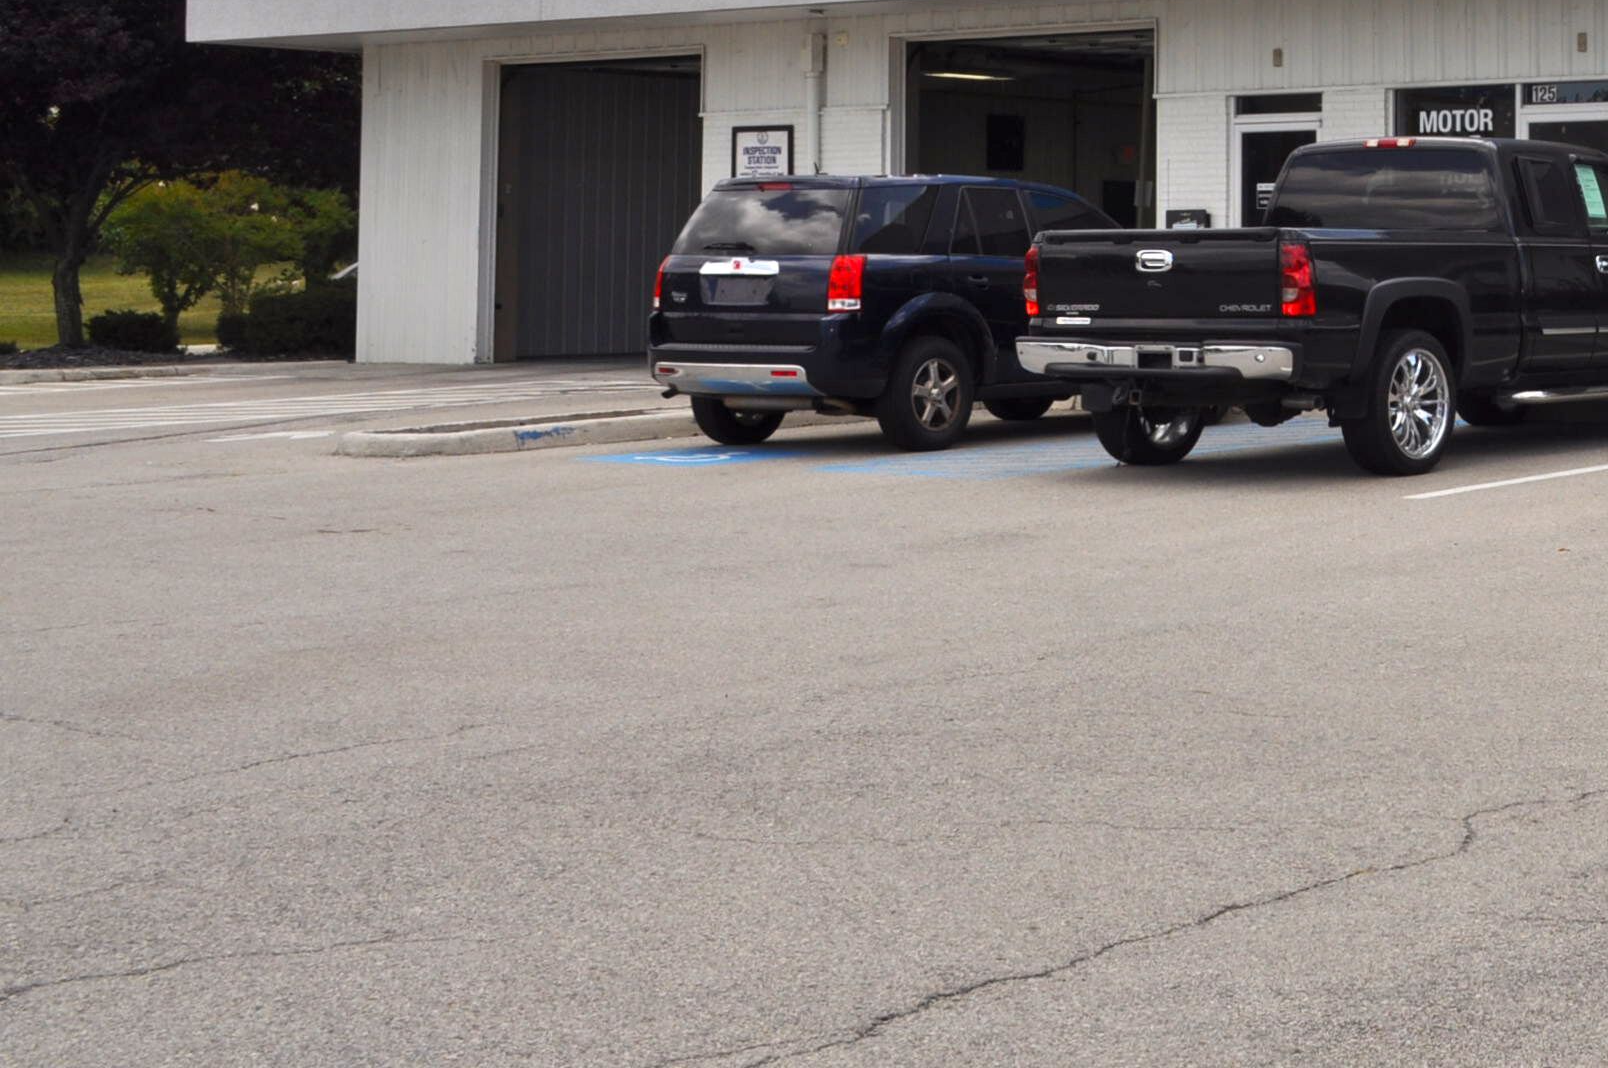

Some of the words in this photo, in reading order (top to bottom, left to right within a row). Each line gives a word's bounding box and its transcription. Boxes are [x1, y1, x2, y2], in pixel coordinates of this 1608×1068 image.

[1532, 85, 1557, 103] 125
[1419, 109, 1494, 134] MOTOR
[1219, 303, 1272, 313] CHEVROLET
